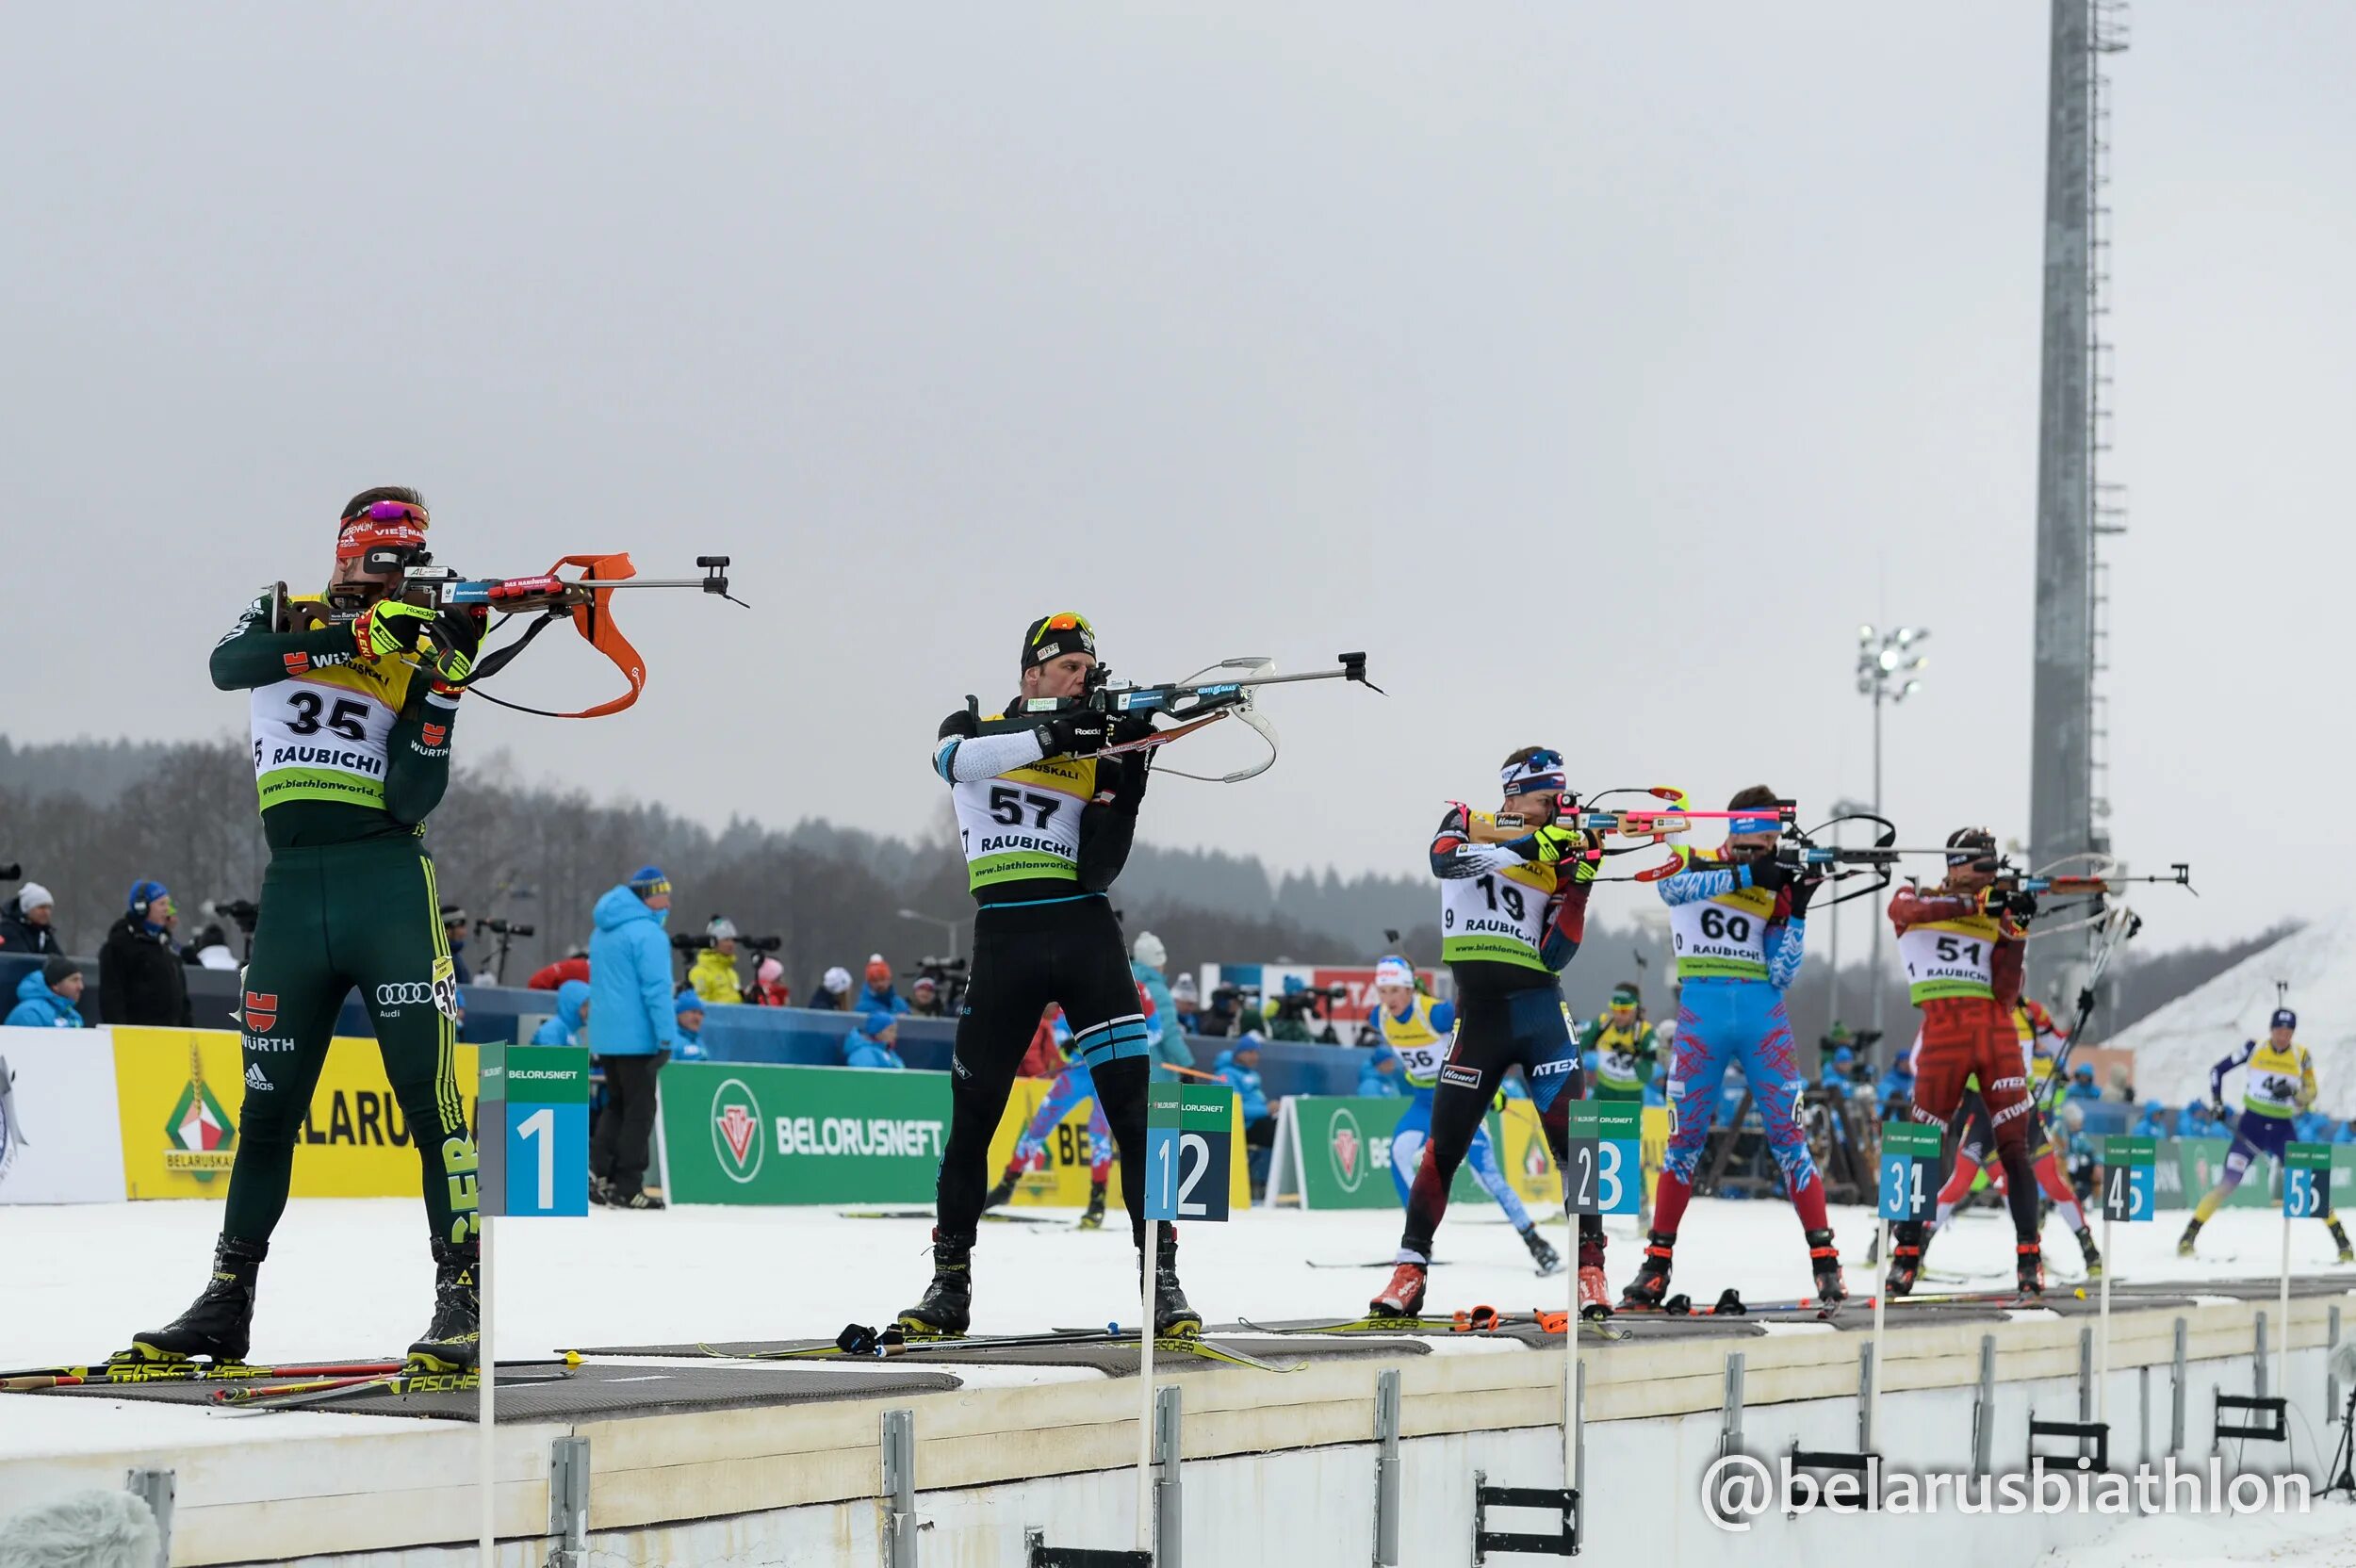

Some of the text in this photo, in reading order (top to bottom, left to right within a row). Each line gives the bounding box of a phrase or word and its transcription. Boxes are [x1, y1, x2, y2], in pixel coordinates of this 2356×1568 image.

[286, 689, 371, 743] 35
[272, 745, 382, 775] RAUBICHI
[990, 784, 1062, 831] 57
[981, 835, 1073, 858] RAUBICHI
[1476, 874, 1526, 923] 19
[1444, 908, 1454, 929] 9
[1700, 906, 1751, 943] 60
[1693, 943, 1761, 961] RAUBICHI
[1935, 936, 1982, 967] 51
[380, 1009, 401, 1018] Audi
[509, 1070, 578, 1080] BELORUSNEFT
[1401, 1050, 1433, 1069] 56
[1532, 1057, 1580, 1077] ATEX
[1181, 1103, 1224, 1114] LORUSNEFT
[775, 1116, 944, 1157] BELORUSNEFT
[516, 1109, 554, 1210] 1
[1158, 1138, 1170, 1210] 1
[1179, 1134, 1211, 1217] 2
[1578, 1147, 1592, 1206] 2
[1598, 1141, 1623, 1211] 3
[1889, 1161, 1905, 1213] 3
[2108, 1168, 2124, 1220] 4
[2289, 1169, 2305, 1217] 5
[1367, 1319, 1419, 1331] FISCHER
